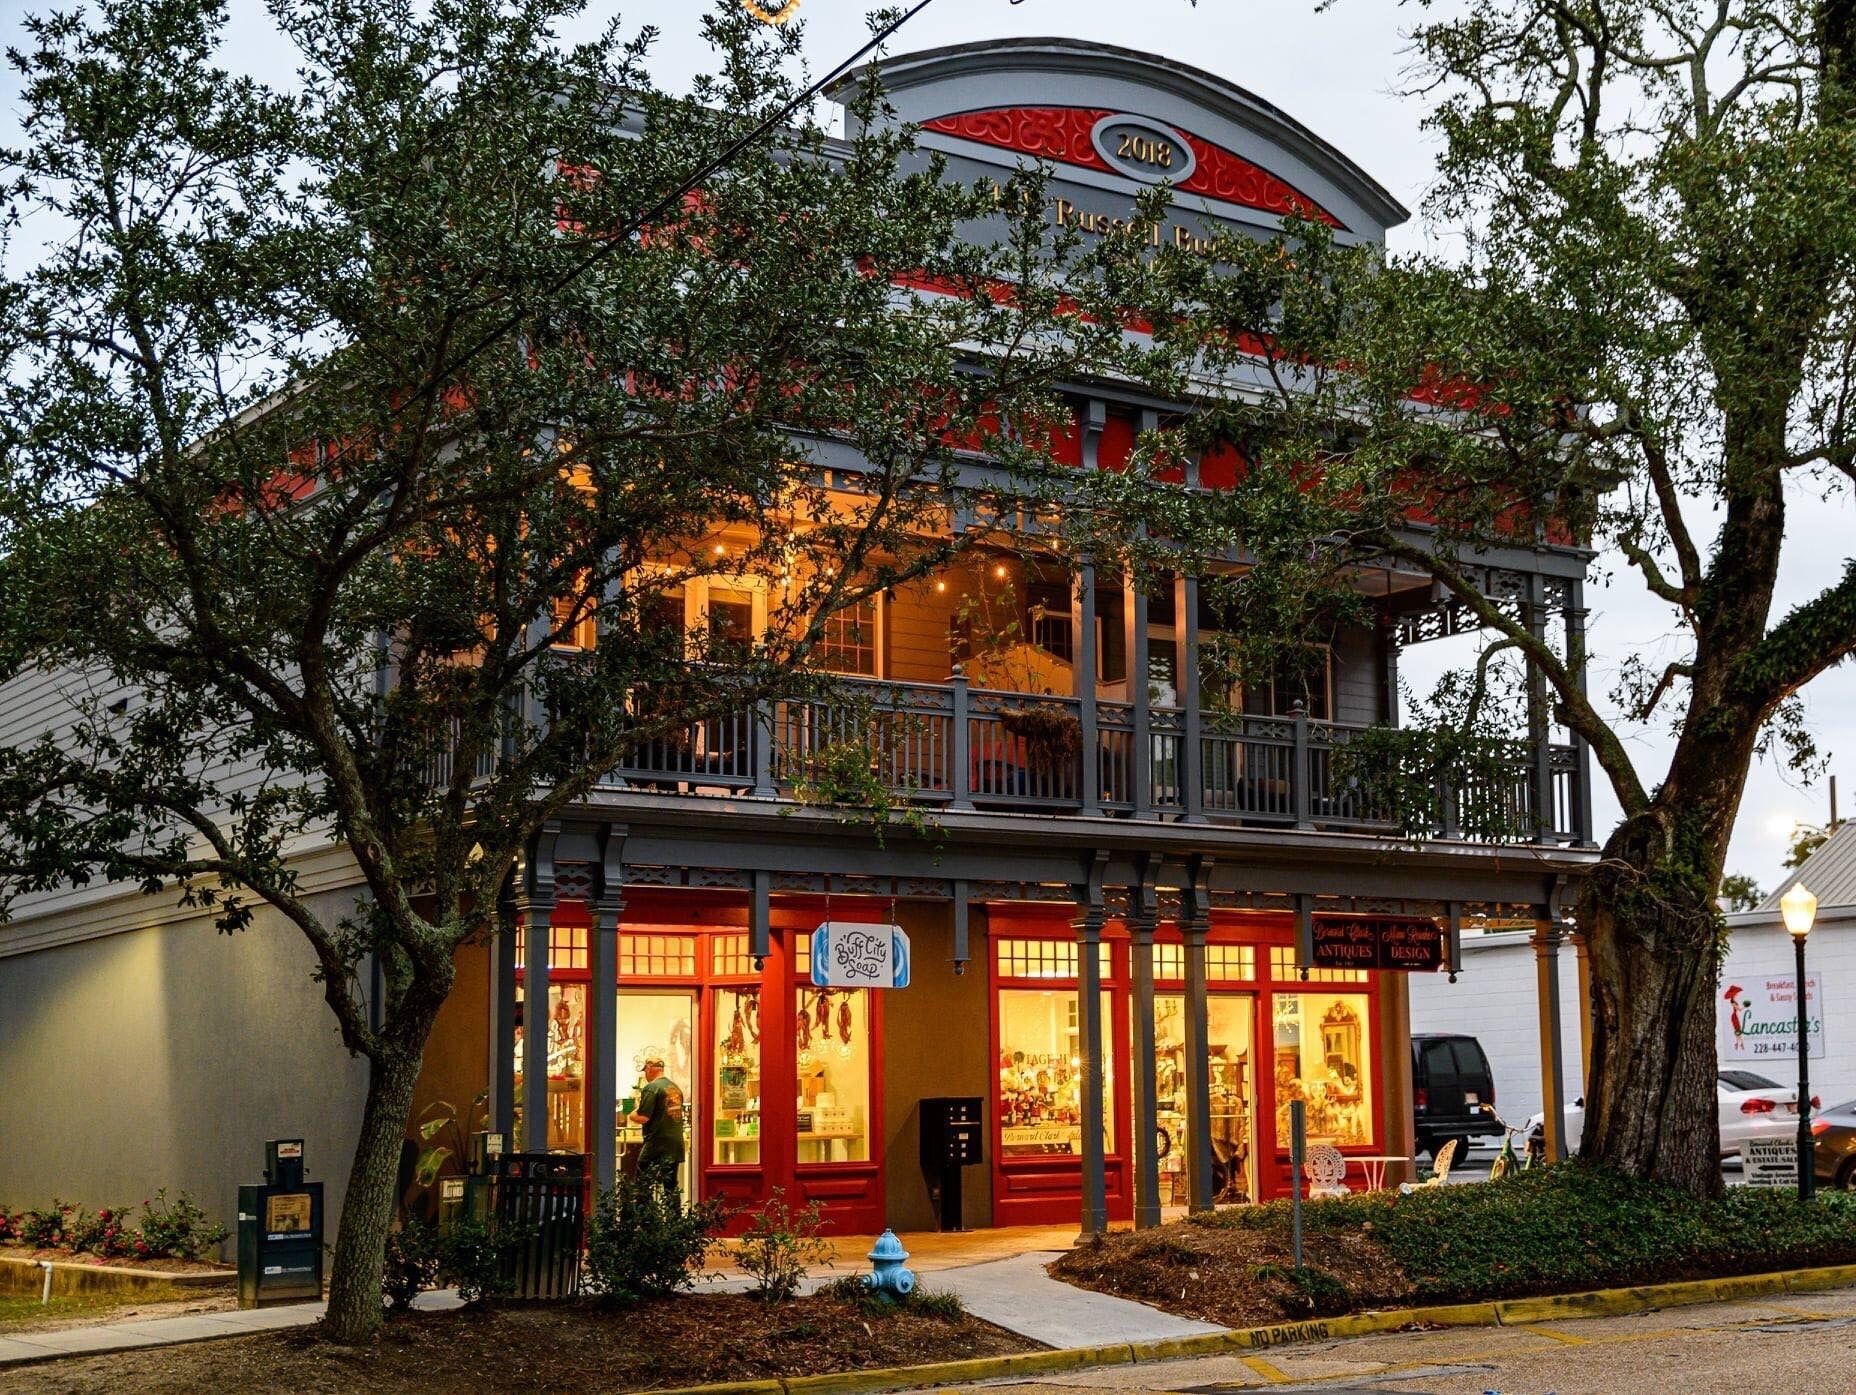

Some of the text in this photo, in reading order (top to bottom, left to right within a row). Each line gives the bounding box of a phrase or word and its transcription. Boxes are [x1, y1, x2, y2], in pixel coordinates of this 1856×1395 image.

[1117, 133, 1173, 168] 2018
[835, 935, 887, 965] Buff City
[1317, 944, 1373, 959] ANTIQUES
[1391, 946, 1431, 959] DESIGN
[846, 959, 880, 980] Soap
[1741, 1009, 1820, 1035] Lancastr's
[1249, 1323, 1329, 1347] NO PARKING
